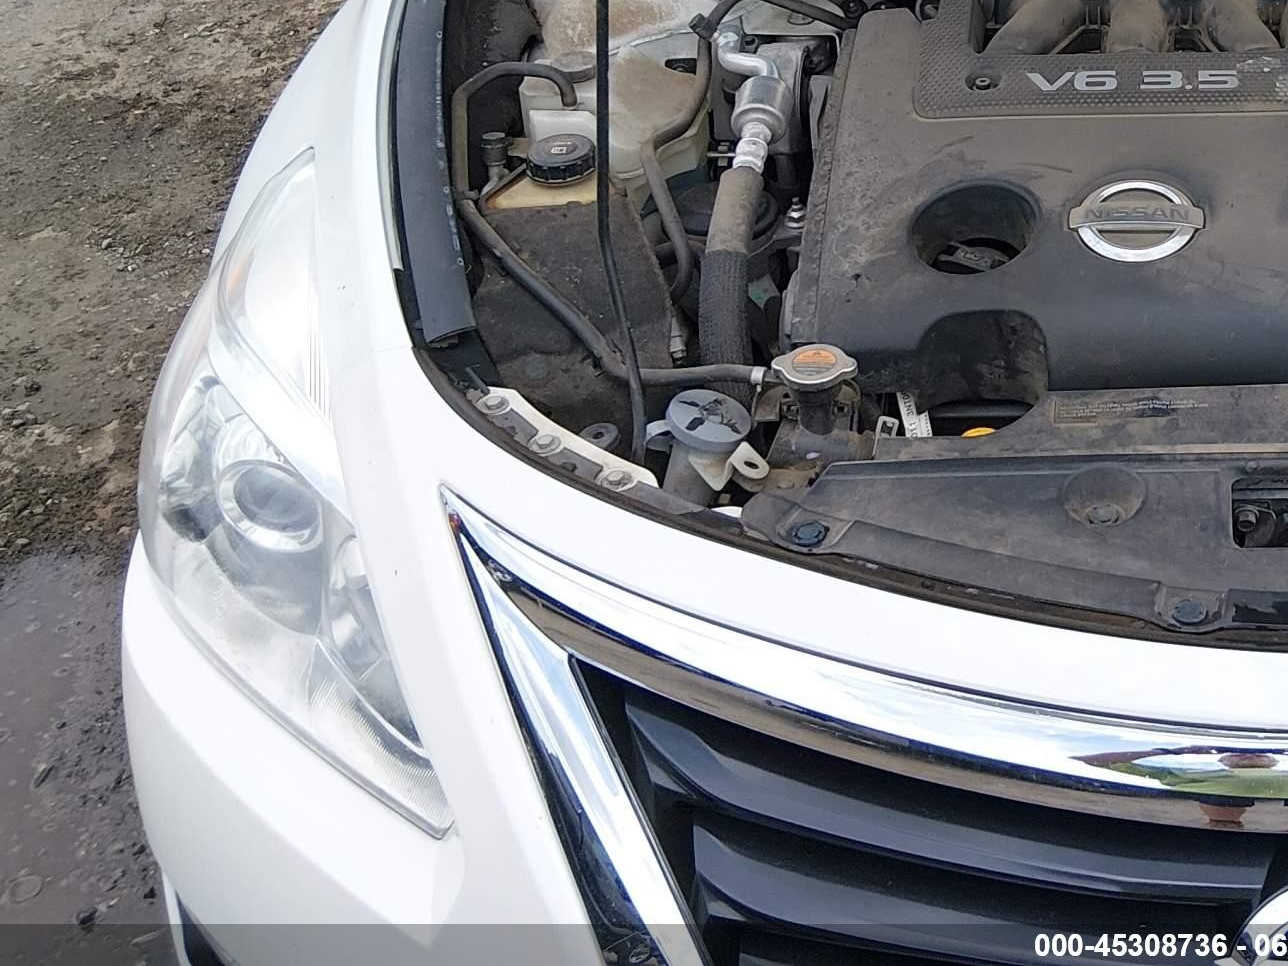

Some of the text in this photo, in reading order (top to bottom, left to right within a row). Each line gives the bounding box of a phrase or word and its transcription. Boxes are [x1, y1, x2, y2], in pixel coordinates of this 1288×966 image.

[1026, 70, 1239, 91] V6 3.5
[1086, 206, 1190, 219] NISSAN
